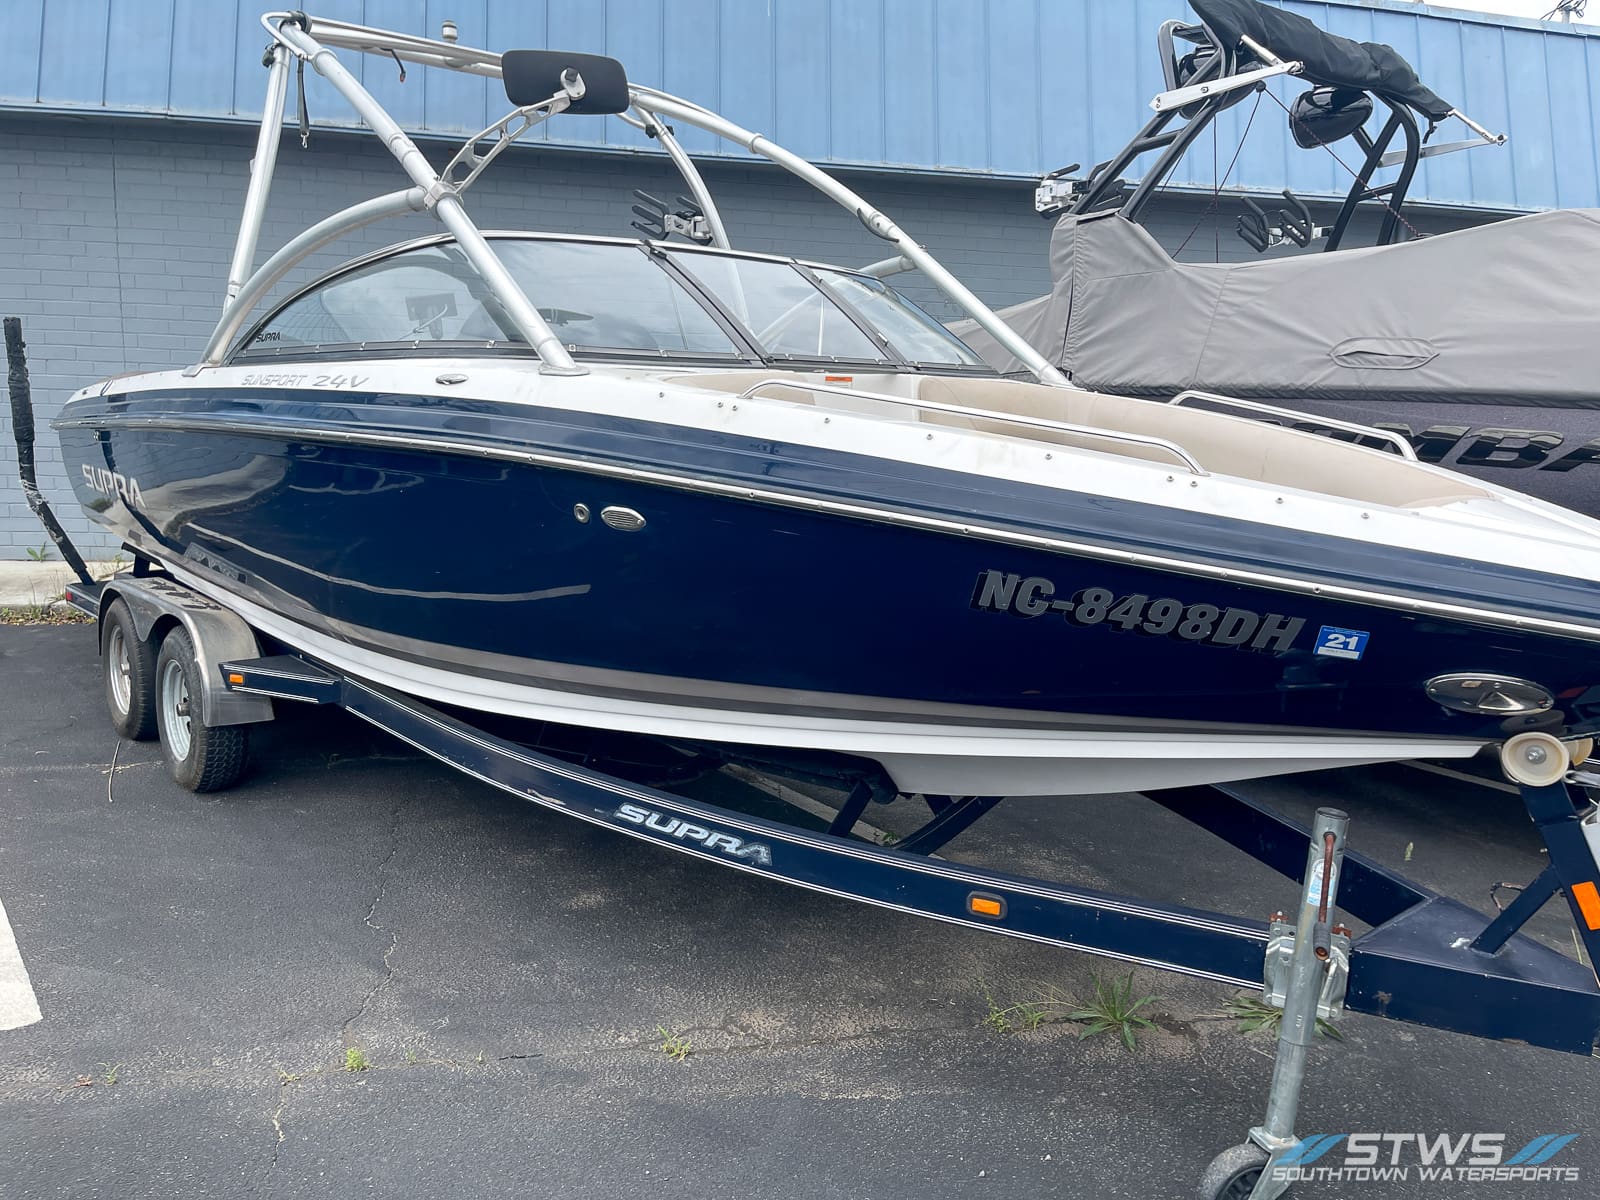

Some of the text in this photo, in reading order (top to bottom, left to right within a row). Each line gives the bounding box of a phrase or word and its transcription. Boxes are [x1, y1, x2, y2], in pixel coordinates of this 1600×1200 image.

[255, 331, 281, 343] SUPRA
[241, 374, 370, 389] SUNSPORT 24V
[82, 463, 147, 509] SUPRA
[969, 568, 1306, 655] NC-8498DH
[1325, 633, 1359, 650] 21
[614, 802, 773, 867] SUPRA
